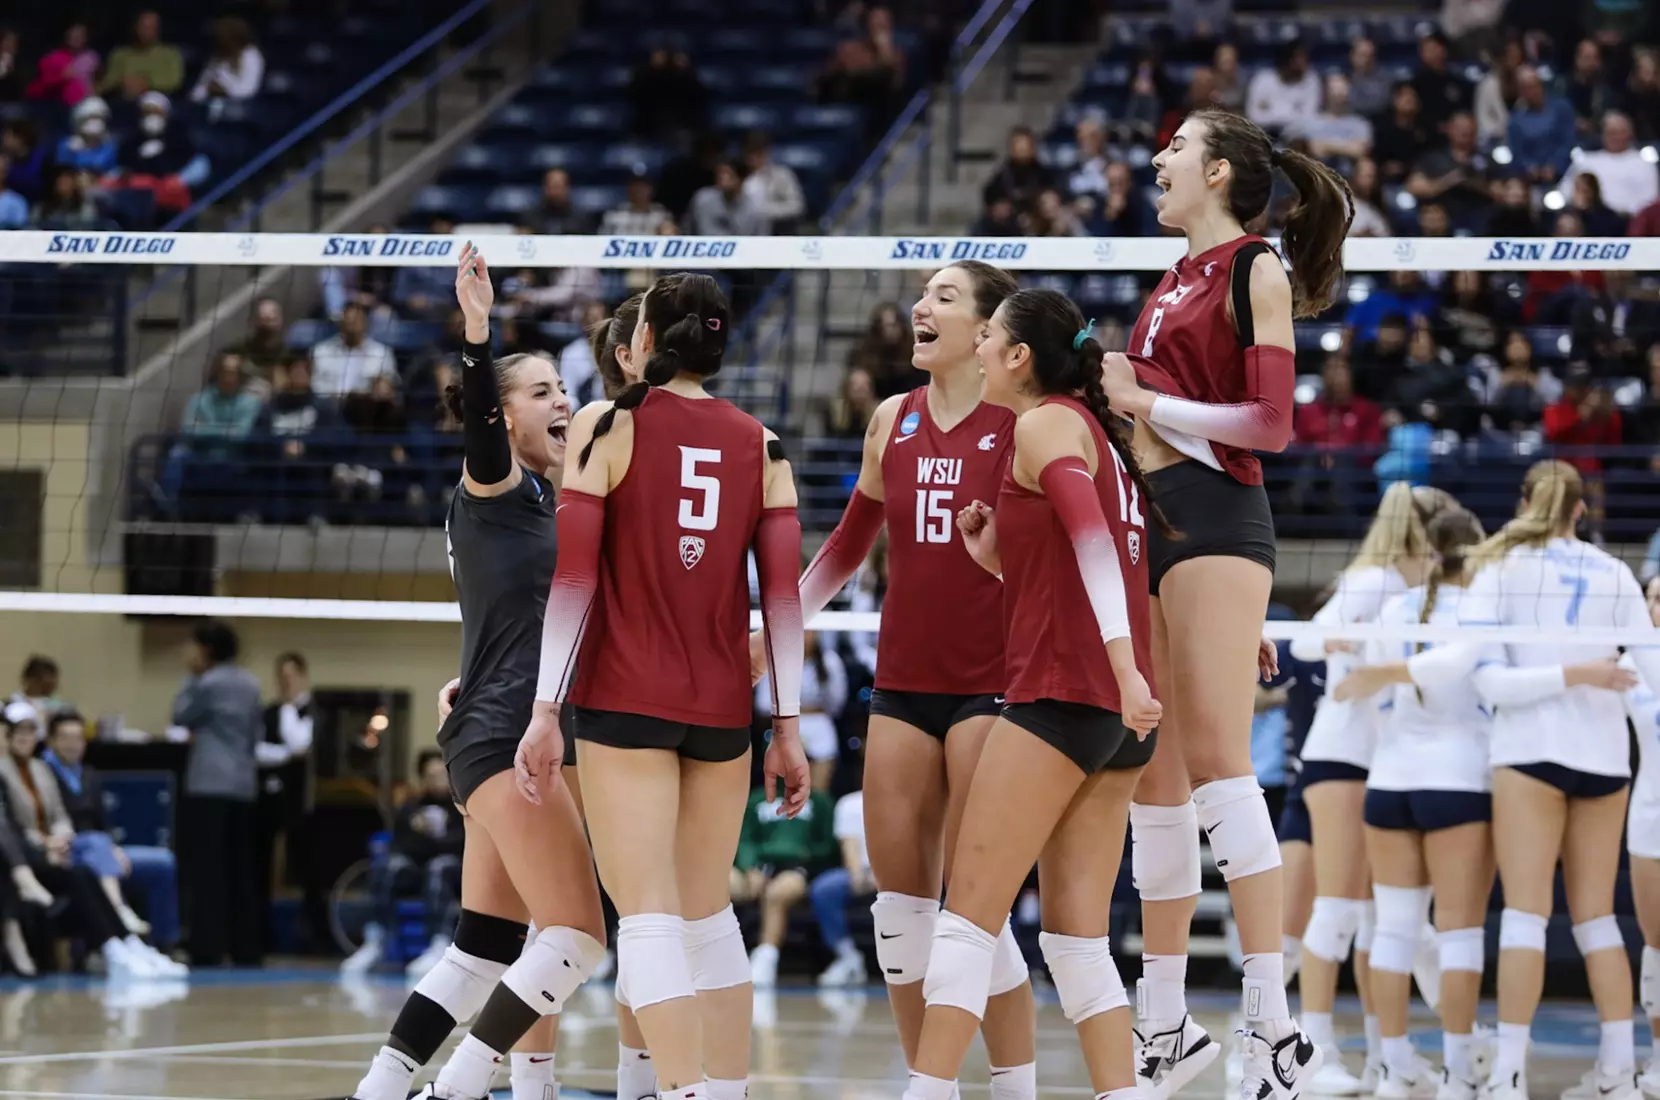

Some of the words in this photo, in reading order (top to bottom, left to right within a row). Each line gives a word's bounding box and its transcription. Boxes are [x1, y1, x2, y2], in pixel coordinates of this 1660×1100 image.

[47, 235, 99, 253] SAN
[103, 236, 176, 254] DIEGO
[323, 237, 377, 255] SAN
[380, 238, 453, 256] DIEGO
[603, 239, 657, 257] SAN
[661, 239, 737, 258] DIEGO
[890, 240, 945, 259] SAN
[950, 241, 1028, 260] DIEGO
[1487, 241, 1545, 260] SAN
[1550, 241, 1631, 260] DIEGO
[916, 456, 963, 485] WSU
[677, 445, 722, 531] 5
[915, 489, 955, 543] 15
[1559, 574, 1589, 627] 7
